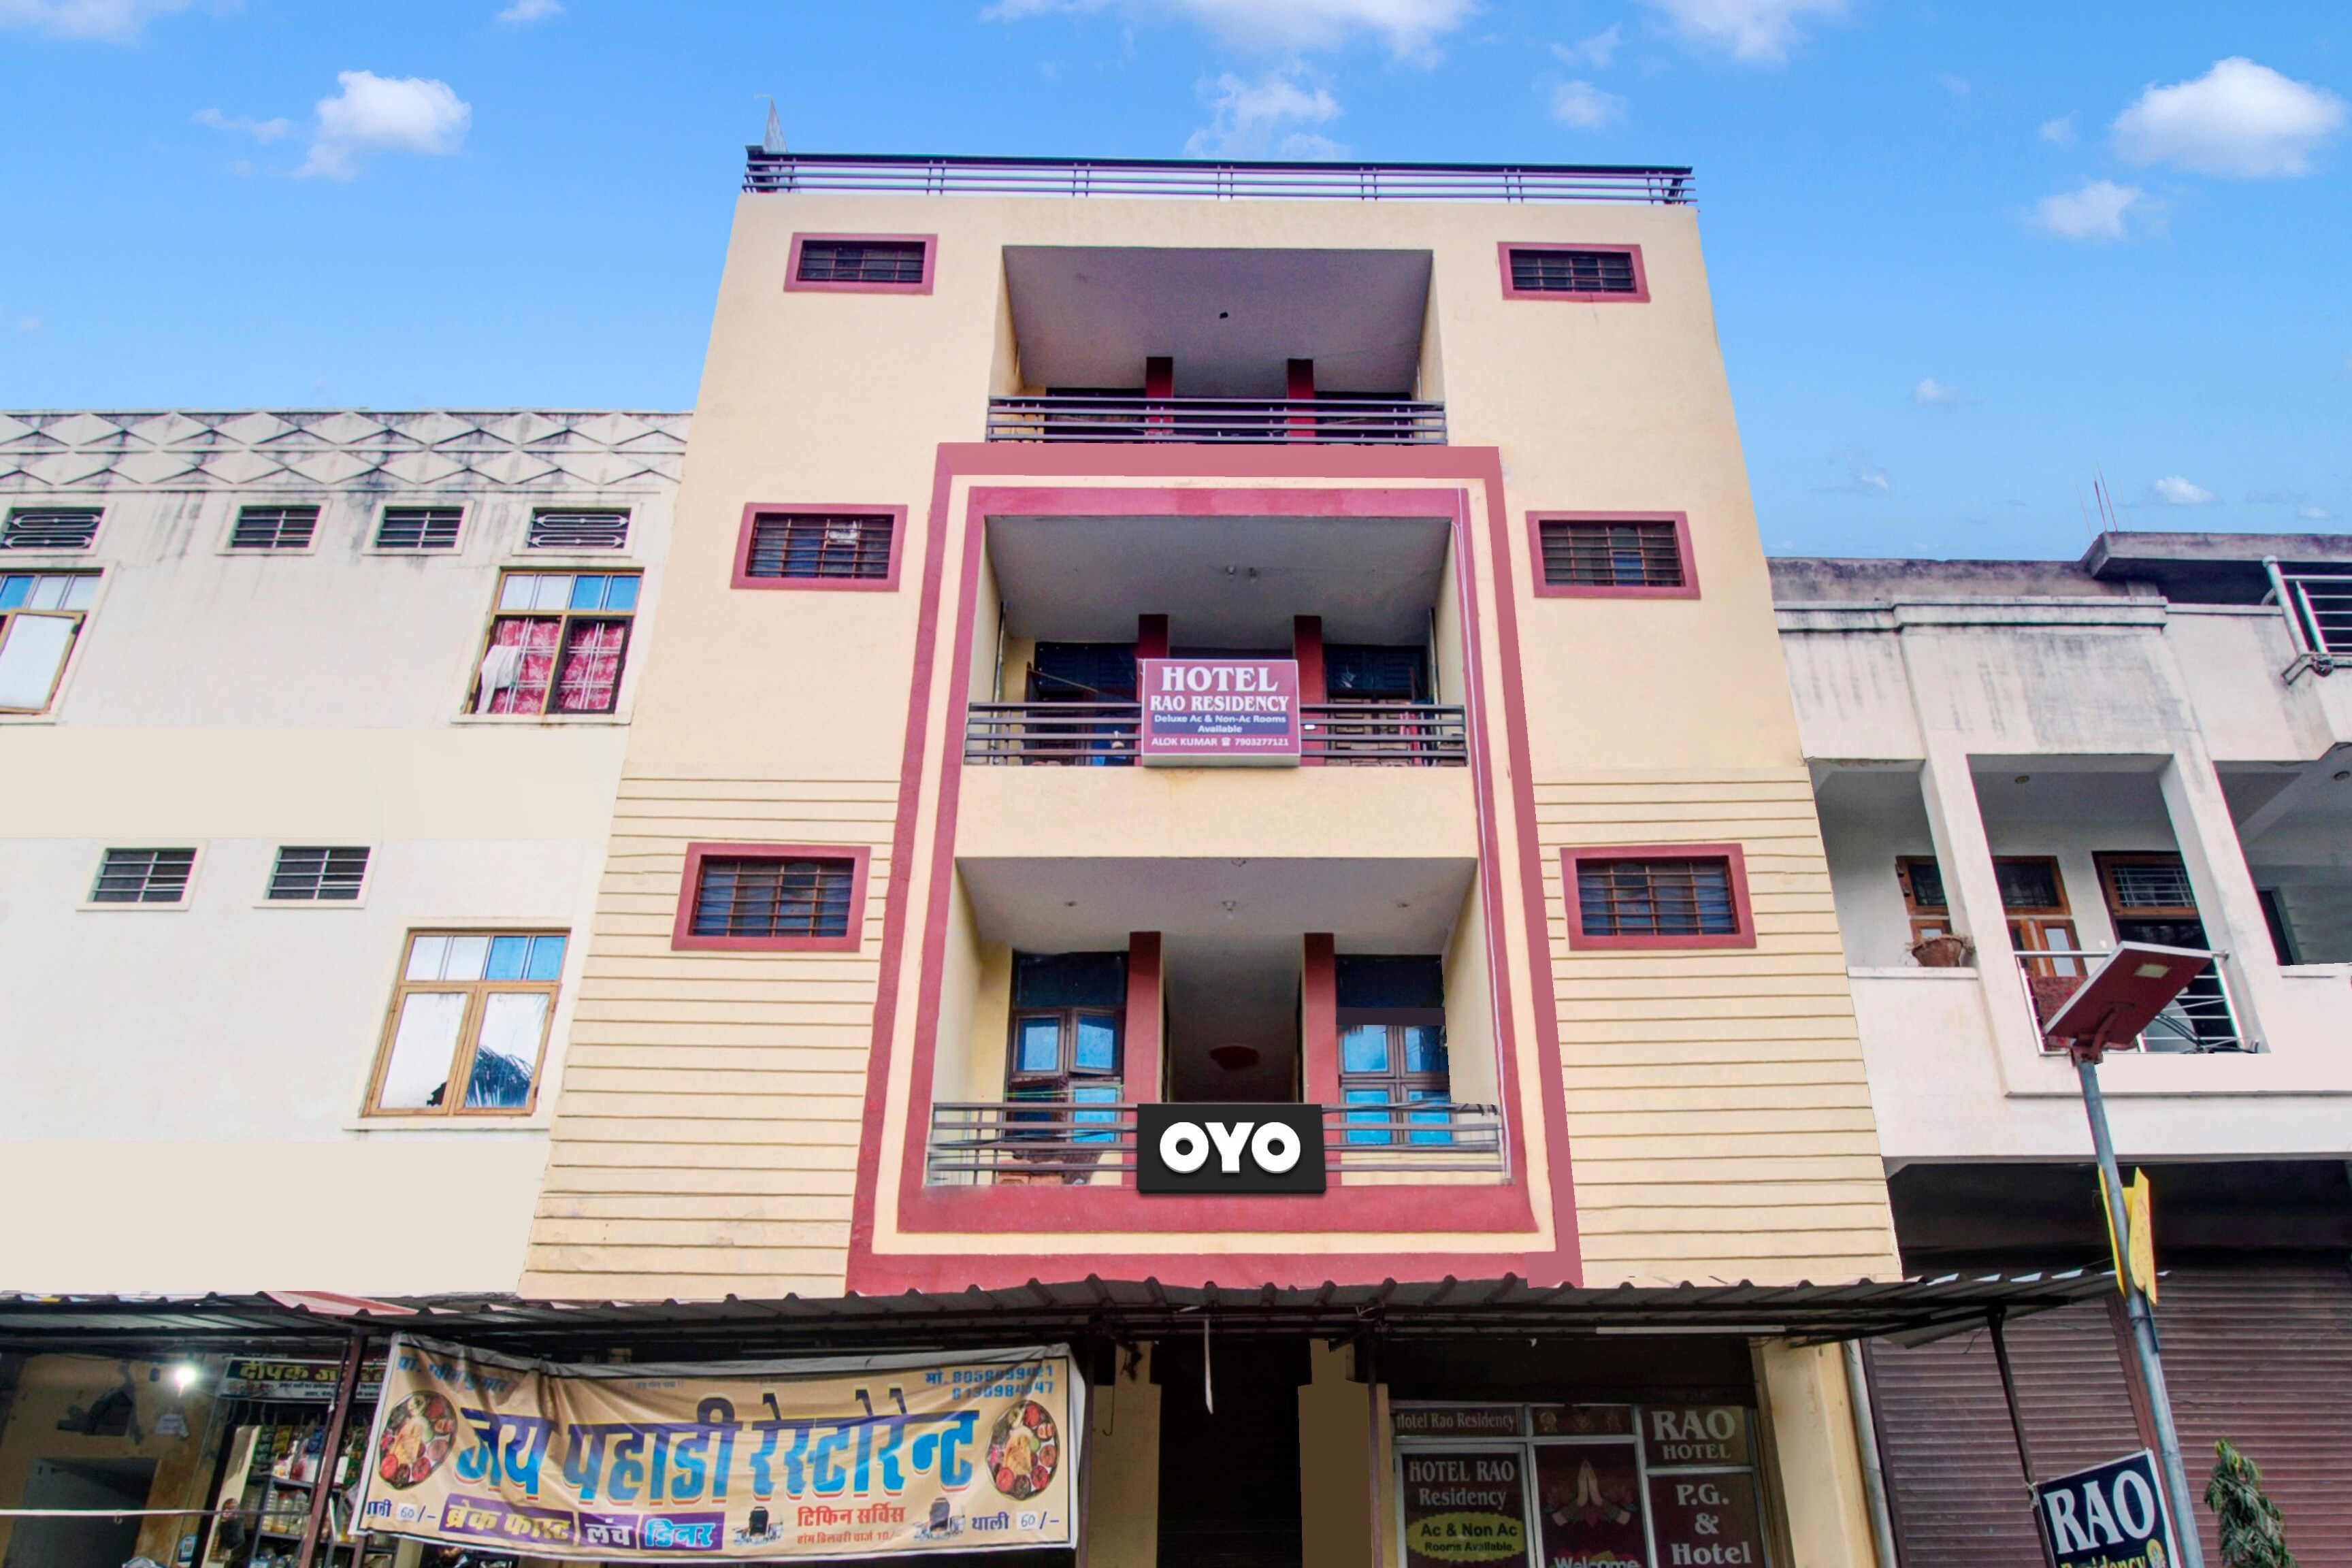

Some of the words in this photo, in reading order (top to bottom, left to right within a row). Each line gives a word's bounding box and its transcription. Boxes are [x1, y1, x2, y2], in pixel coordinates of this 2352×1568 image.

[1162, 666, 1278, 691] HOTEL
[1150, 696, 1186, 711] RAO
[1191, 696, 1290, 711] RESIDENCY
[1154, 715, 1188, 723] Deluxe
[1190, 715, 1202, 723] Ac
[1204, 715, 1212, 723] &
[1215, 715, 1250, 723] Non-Ac
[1253, 715, 1286, 723] Rooms
[1198, 725, 1242, 733] Available
[1152, 738, 1177, 746] ALOK
[1180, 738, 1218, 746] KUMAR
[1160, 1122, 1301, 1173] OYO
[1431, 1413, 1453, 1428] Rao
[1457, 1412, 1516, 1431] Residency
[1651, 1409, 1735, 1440] RAO
[455, 1406, 561, 1500] जय
[1663, 1444, 1731, 1459] HOTEL
[1409, 1460, 1470, 1482] HOTEL
[1476, 1460, 1514, 1482] RAO
[1419, 1487, 1506, 1510] Residency
[1676, 1484, 1729, 1505] P.G.
[798, 1505, 853, 1526] टिफिन
[858, 1502, 906, 1524] सर्विस
[972, 1512, 1009, 1531] थाली
[2043, 1470, 2155, 1555] RAO
[585, 1518, 633, 1545] लंच
[644, 1518, 716, 1547] डिनर
[1421, 1523, 1440, 1536] Ac
[1446, 1523, 1457, 1536] &
[1462, 1523, 1492, 1536] Non
[1497, 1523, 1517, 1536] Ac
[1695, 1513, 1719, 1534] &
[1425, 1542, 1461, 1551] Rooms
[1465, 1541, 1516, 1552] Available.
[1671, 1541, 1752, 1565] Hotel
